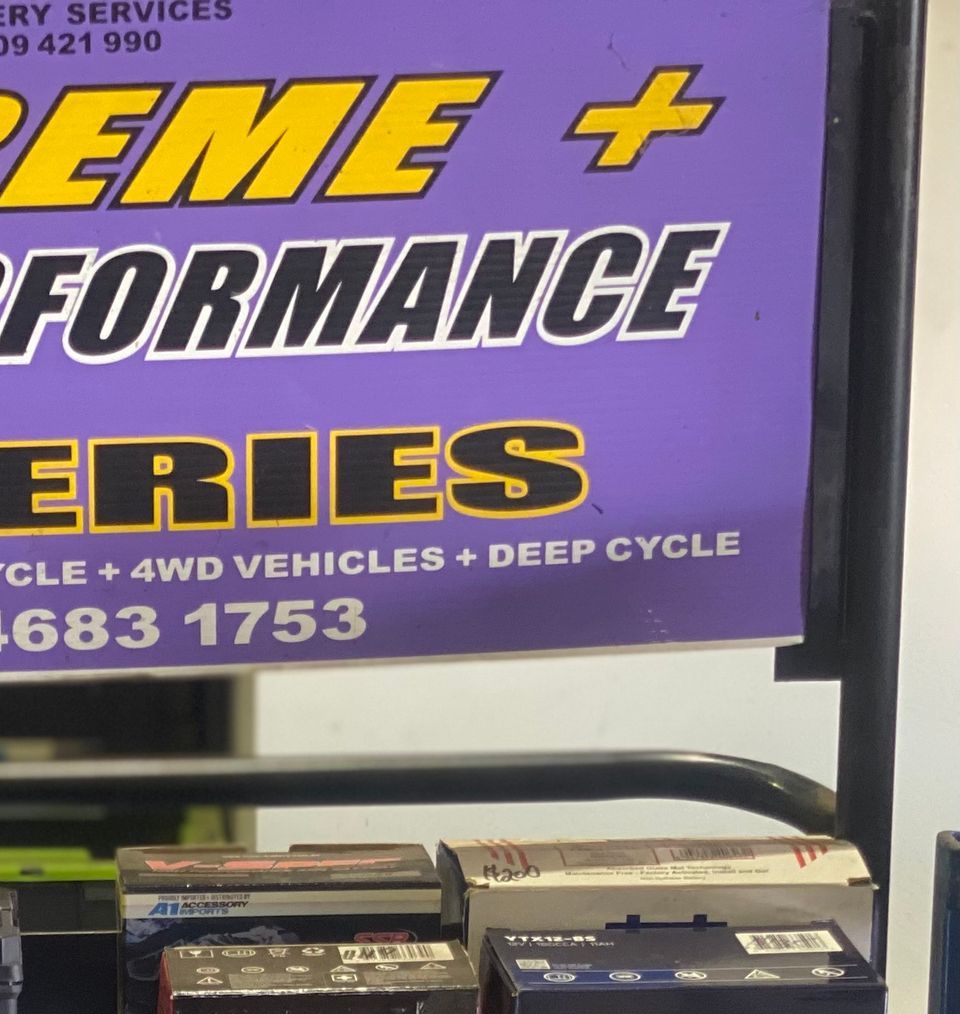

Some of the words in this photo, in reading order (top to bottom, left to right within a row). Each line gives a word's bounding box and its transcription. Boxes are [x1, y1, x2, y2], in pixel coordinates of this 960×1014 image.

[66, 0, 233, 25] SERVICES
[37, 31, 93, 56] 421
[103, 29, 163, 54] 990
[131, 556, 224, 584] 4WD
[234, 546, 445, 580] VEHICLES
[488, 539, 596, 569] DEEP
[606, 532, 741, 561] CYCLE
[183, 597, 367, 647] 1753
[181, 901, 250, 909] ACCESSORY
